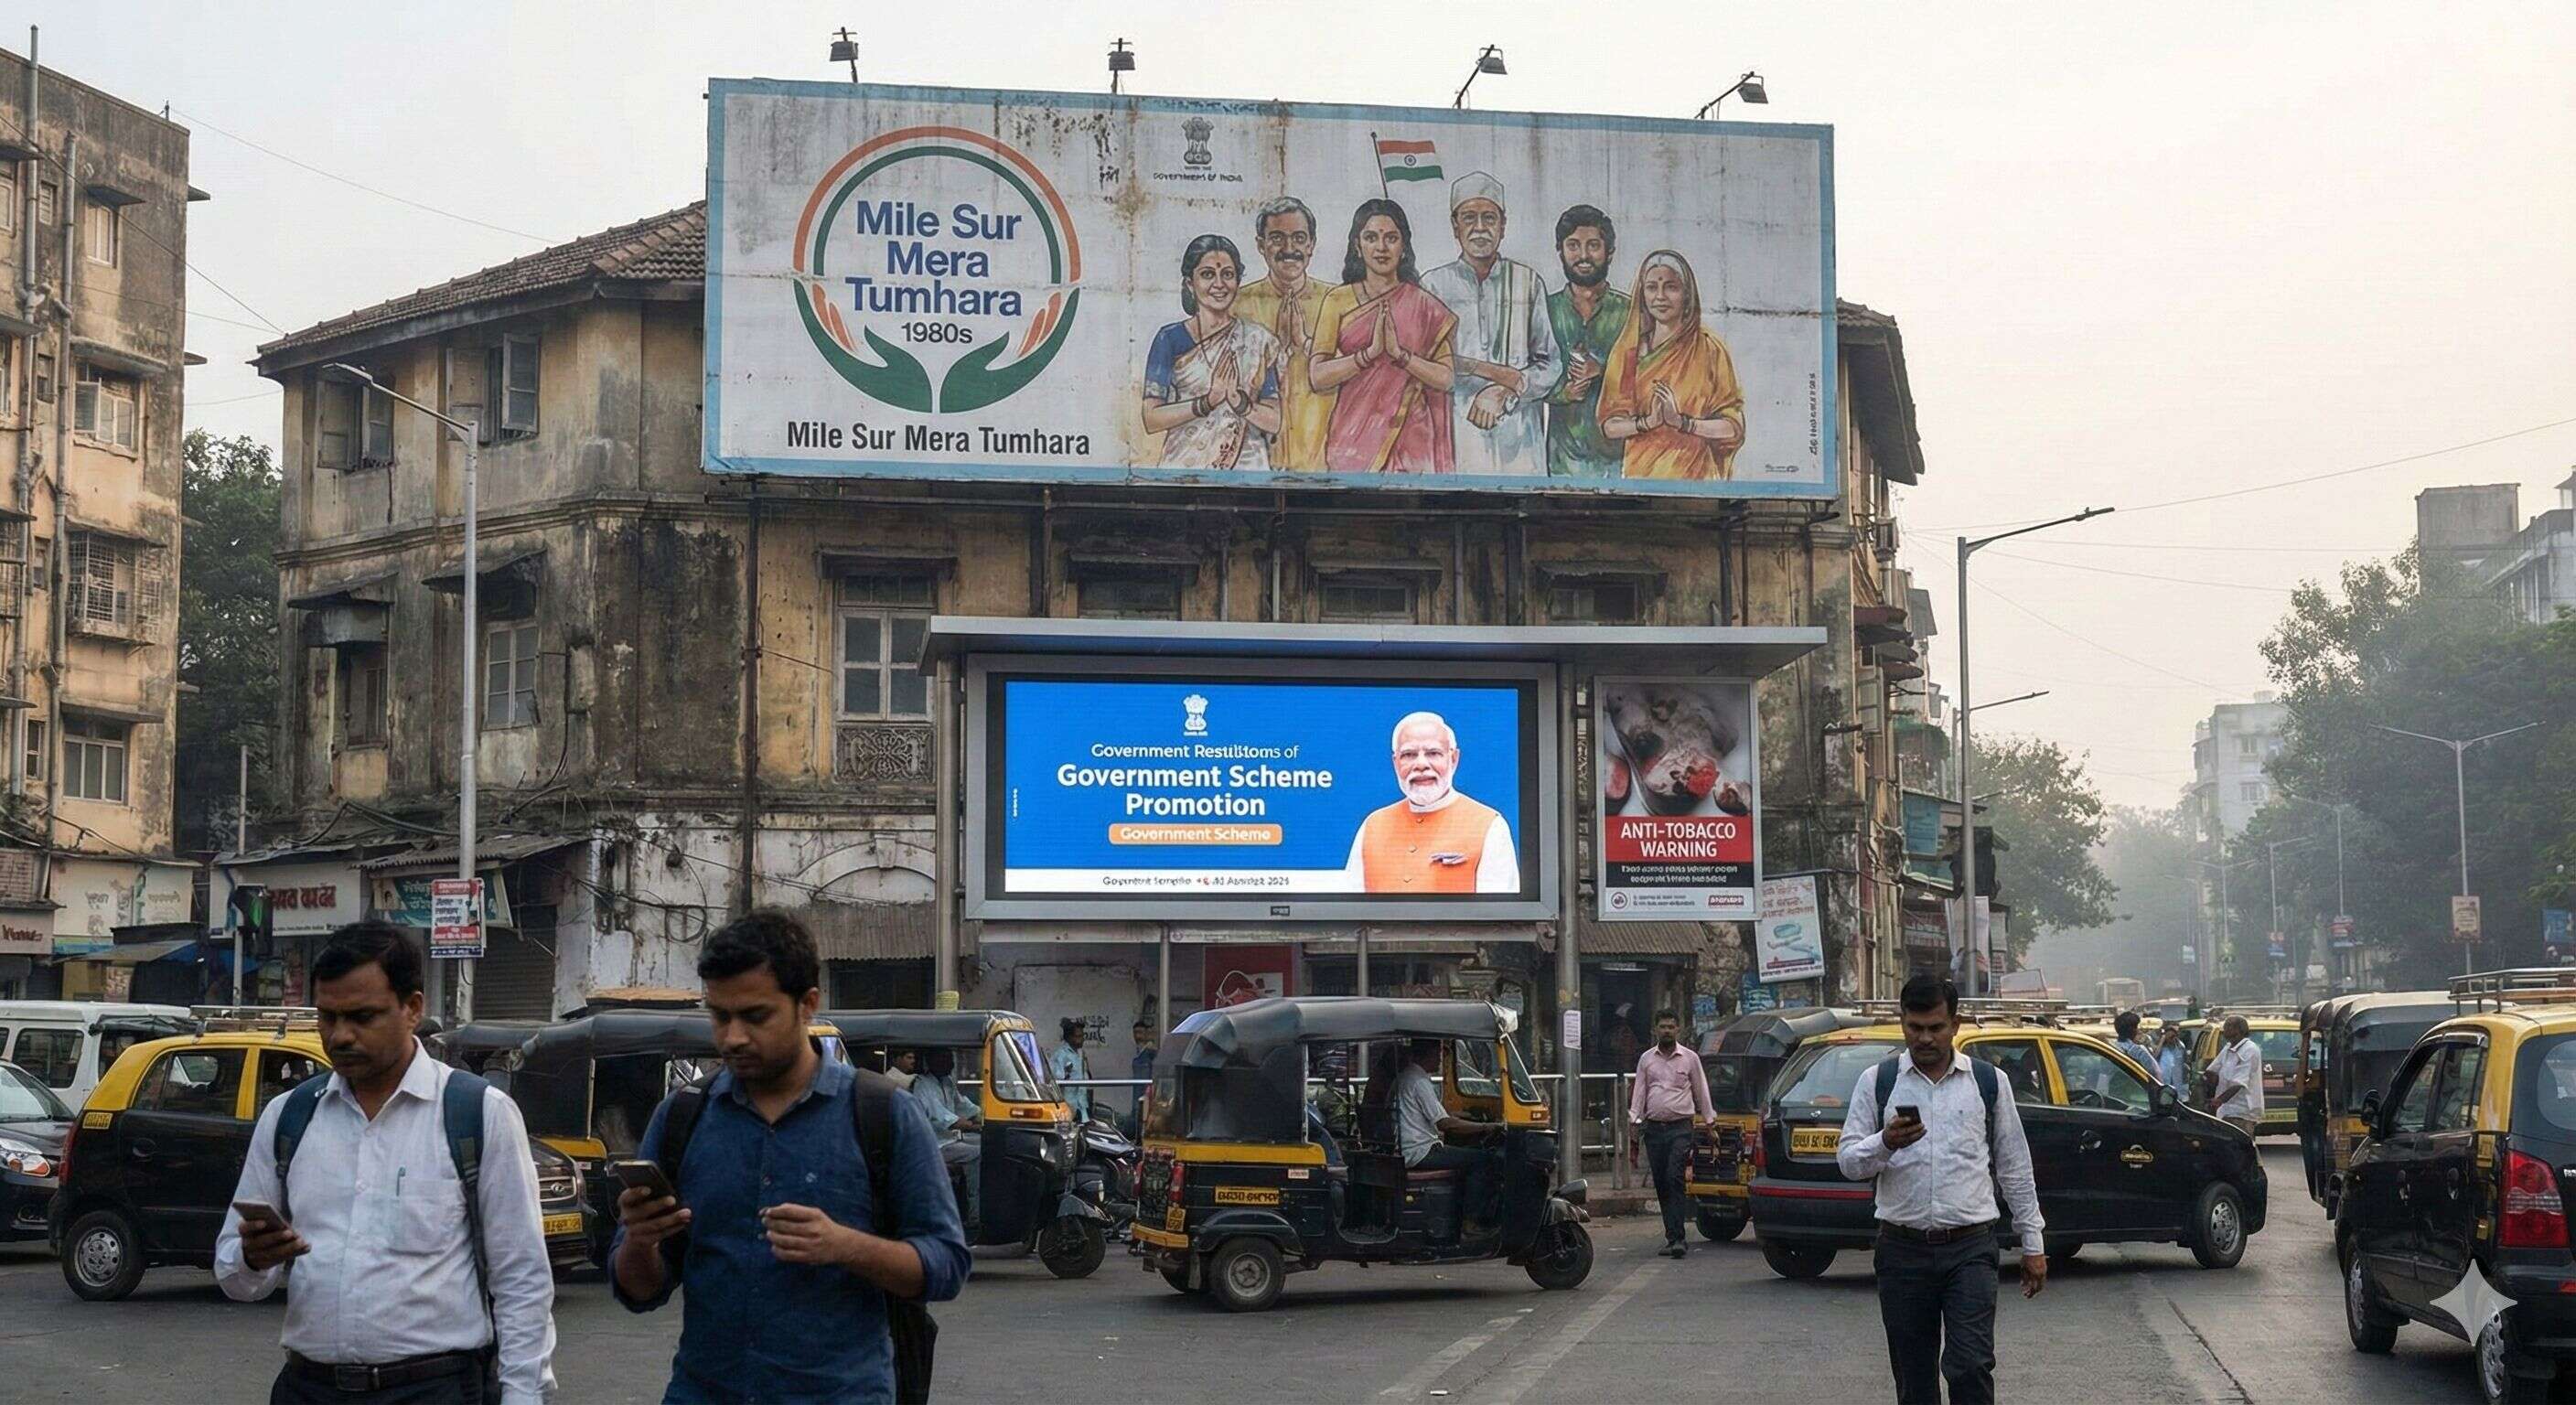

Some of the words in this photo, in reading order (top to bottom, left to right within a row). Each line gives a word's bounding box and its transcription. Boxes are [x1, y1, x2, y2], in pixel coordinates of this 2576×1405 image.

[856, 200, 940, 238] Mile
[952, 203, 1022, 241] Sur
[886, 241, 990, 278] Mera
[844, 277, 1022, 316] Tumhara
[900, 322, 973, 344] 1980s
[787, 421, 843, 449] Mile
[852, 423, 896, 450] Sur
[905, 424, 969, 453] Mera
[979, 426, 1089, 456] Tumhara
[1091, 744, 1189, 758] Government
[1283, 745, 1299, 759] of
[1057, 764, 1221, 788] Government
[1229, 765, 1333, 788] Scheme
[1126, 792, 1266, 817] Promotion
[1620, 822, 1736, 840] ANTI-TOBACCO
[1639, 841, 1718, 858] WARNING
